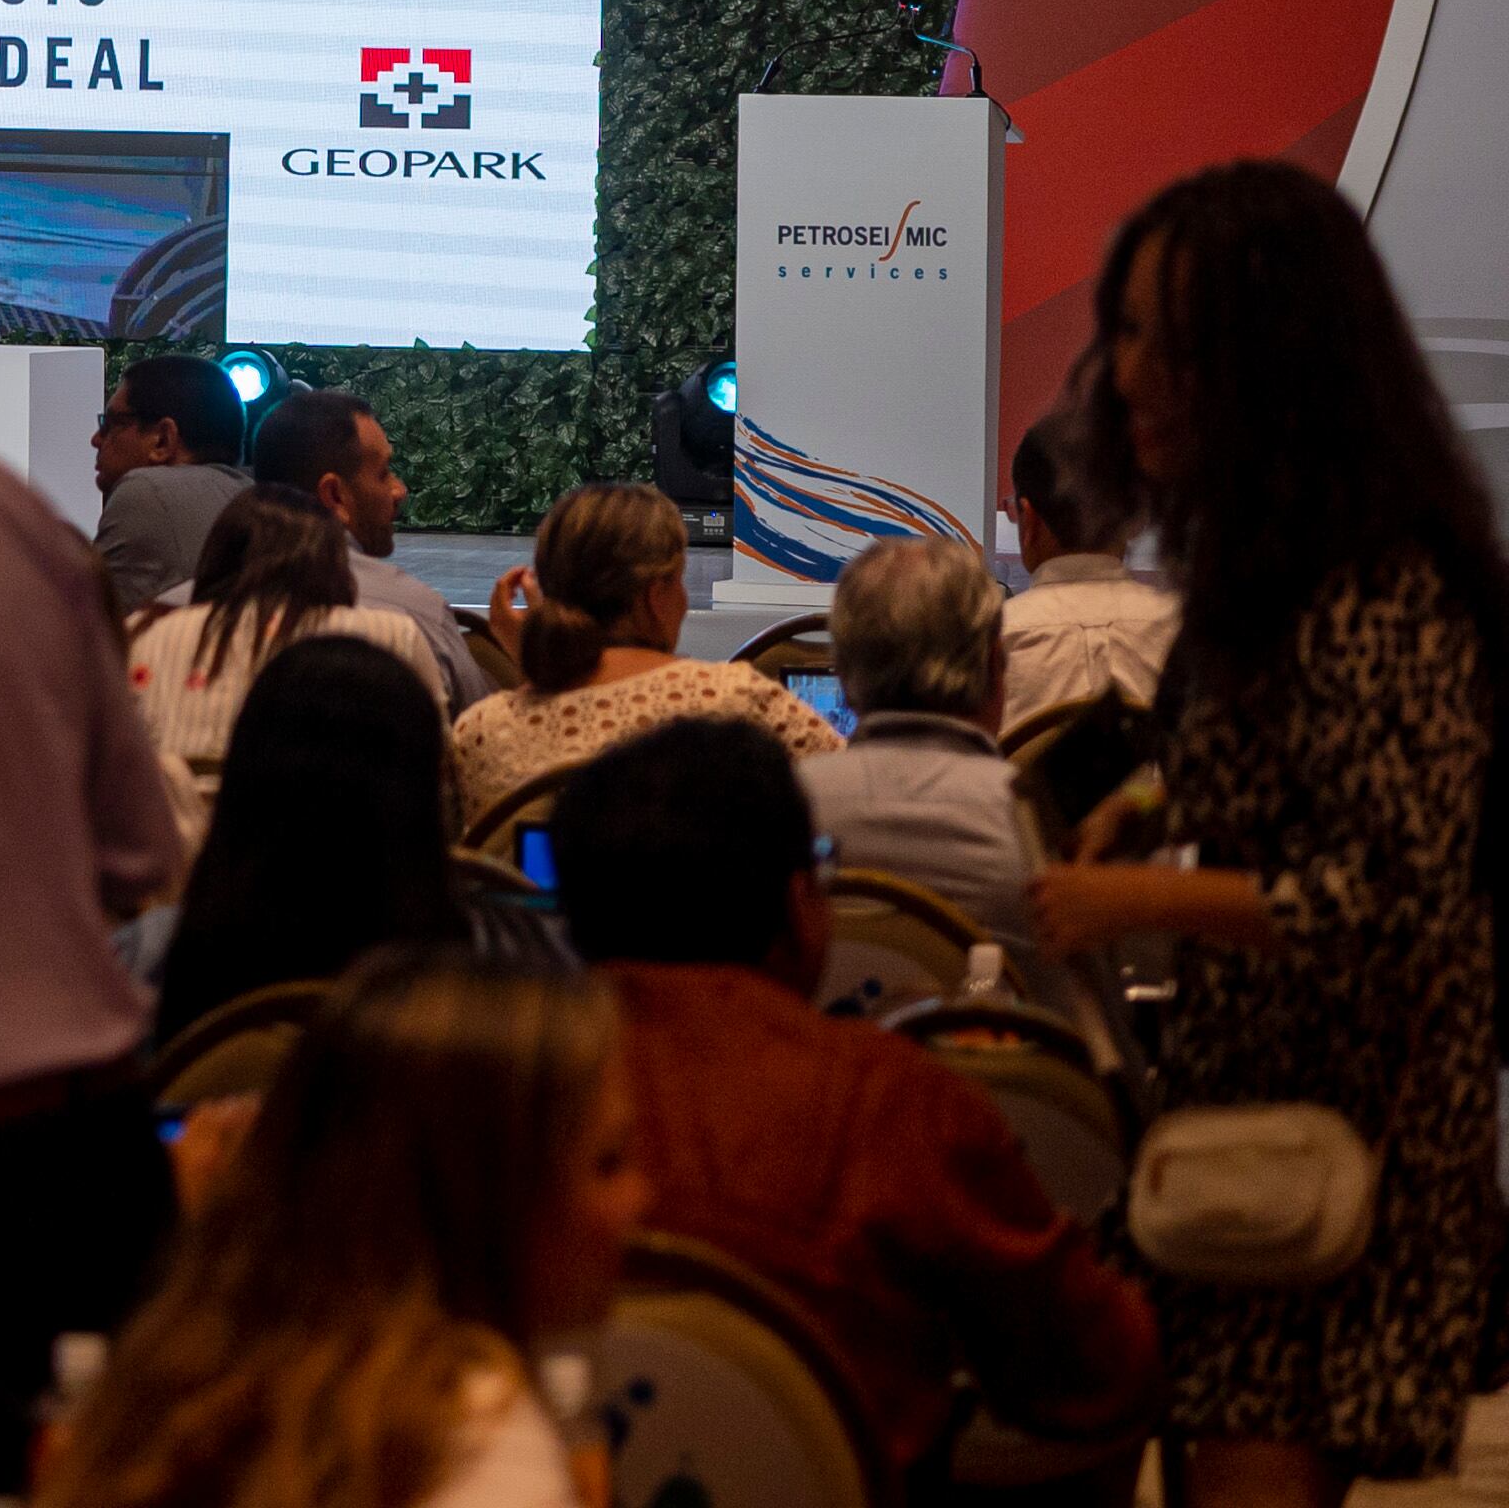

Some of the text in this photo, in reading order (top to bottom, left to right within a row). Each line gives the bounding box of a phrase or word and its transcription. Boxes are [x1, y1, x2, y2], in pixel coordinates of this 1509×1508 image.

[281, 147, 547, 181] GEOPARK
[777, 200, 948, 262] PETROSEISMIC
[778, 263, 949, 281] services
